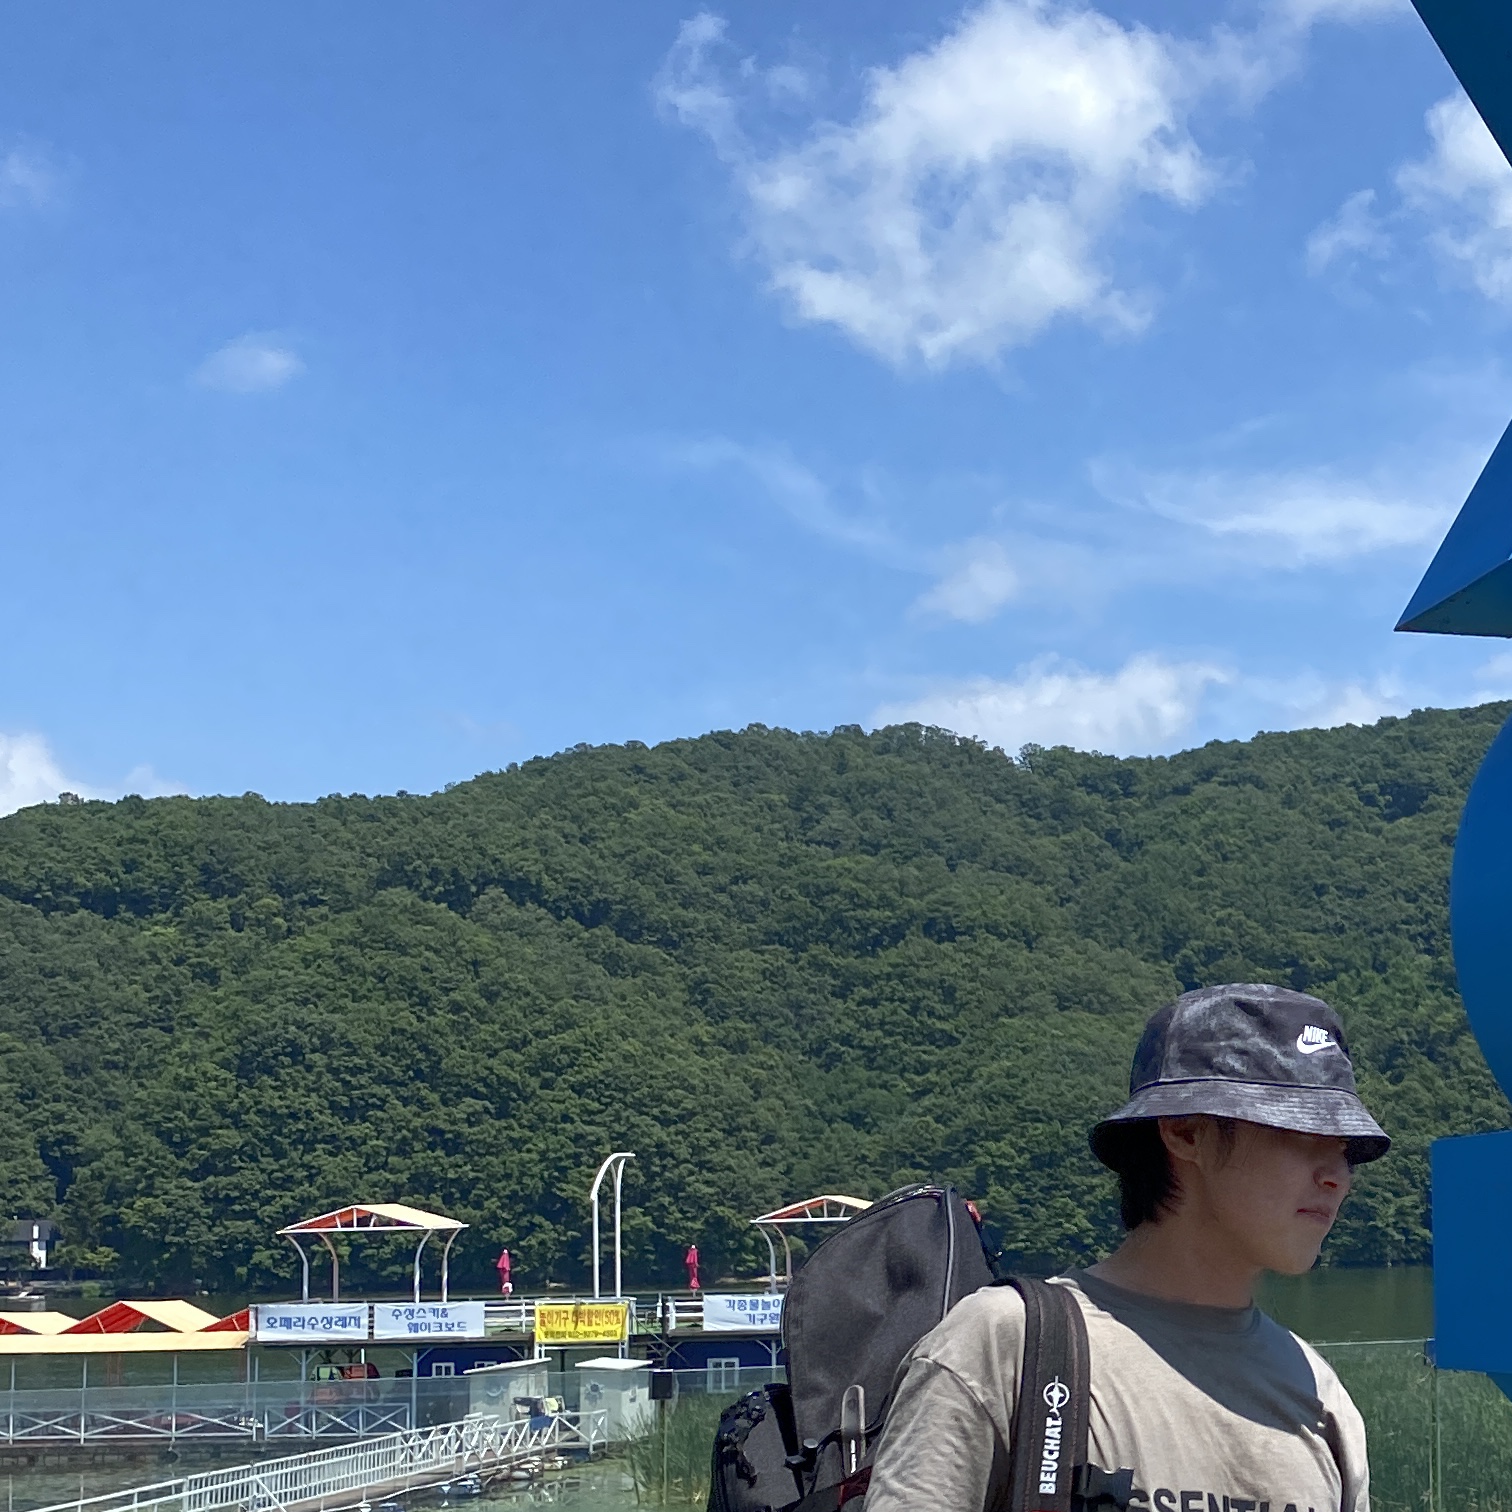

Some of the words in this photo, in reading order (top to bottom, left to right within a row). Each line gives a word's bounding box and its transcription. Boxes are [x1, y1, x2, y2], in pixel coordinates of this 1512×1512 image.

[1302, 1025, 1329, 1043] NIKE
[407, 1321, 468, 1334] 웨이크보드
[1039, 1416, 1063, 1495] BEUCHAT
